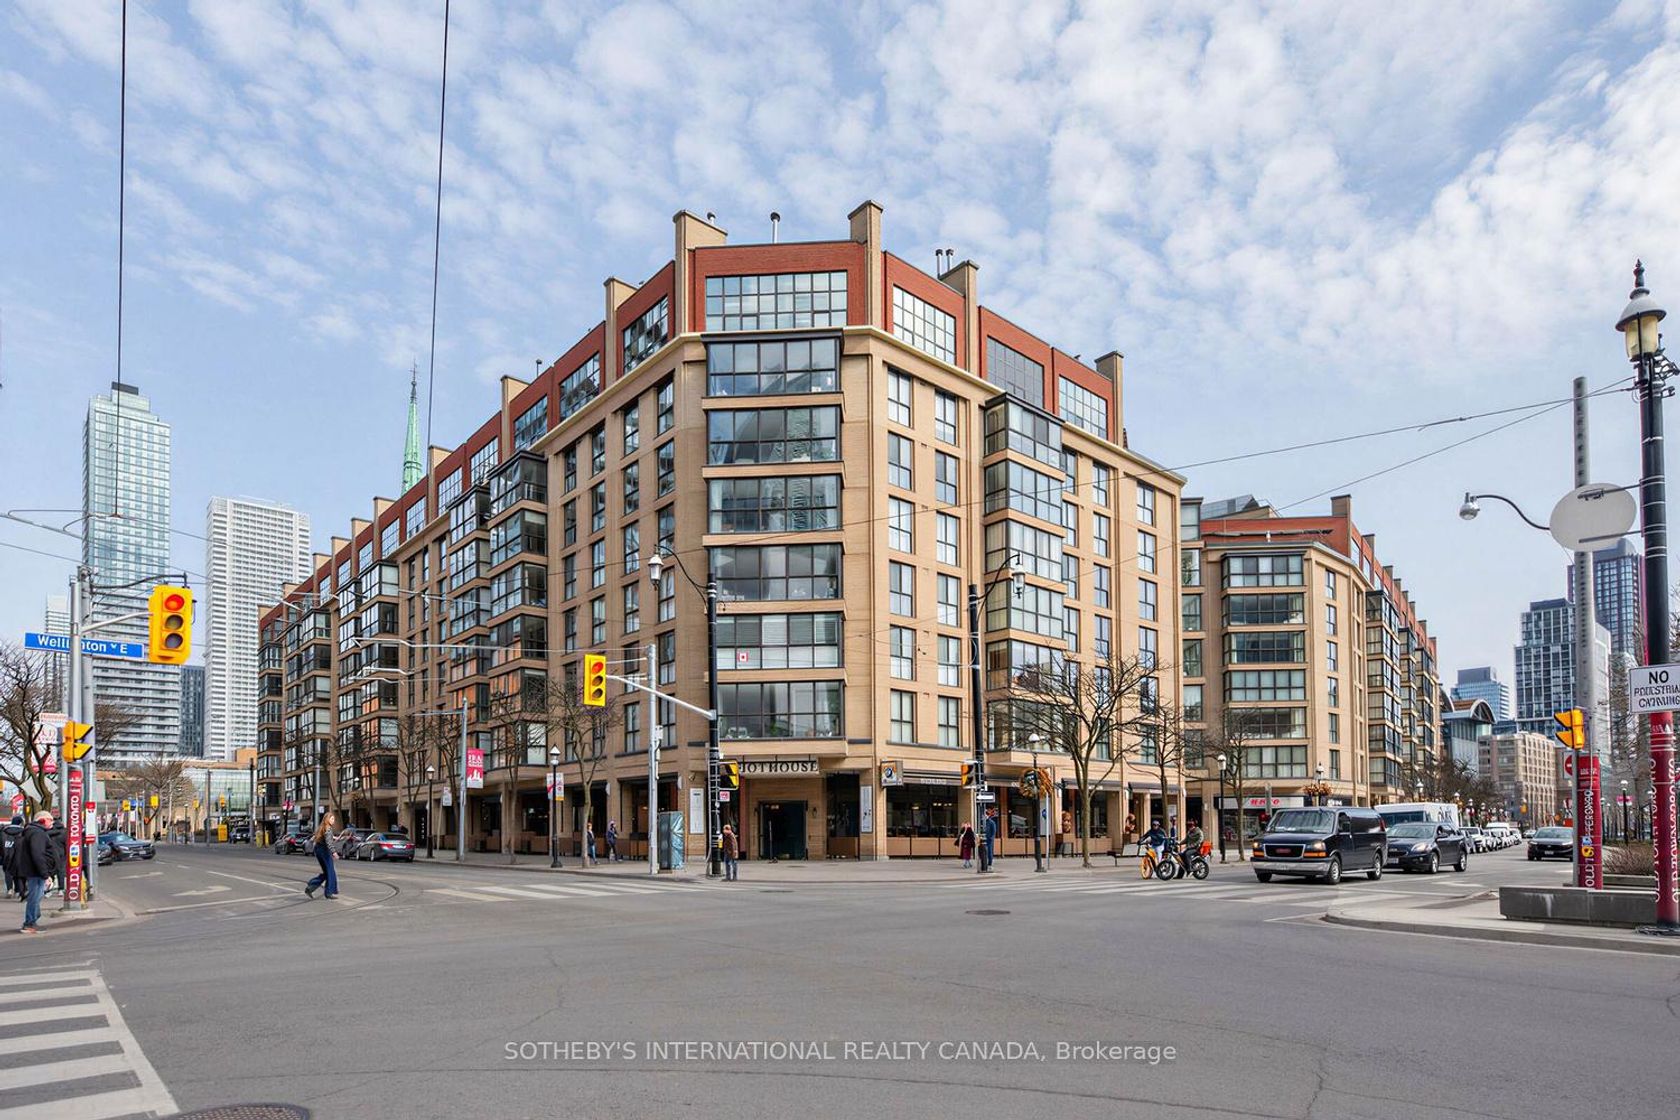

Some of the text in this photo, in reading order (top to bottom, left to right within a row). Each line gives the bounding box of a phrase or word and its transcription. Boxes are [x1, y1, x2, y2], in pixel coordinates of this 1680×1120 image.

[37, 635, 106, 652] Welliton
[120, 643, 128, 653] E
[1649, 670, 1669, 684] NO
[68, 873, 80, 900] OLD
